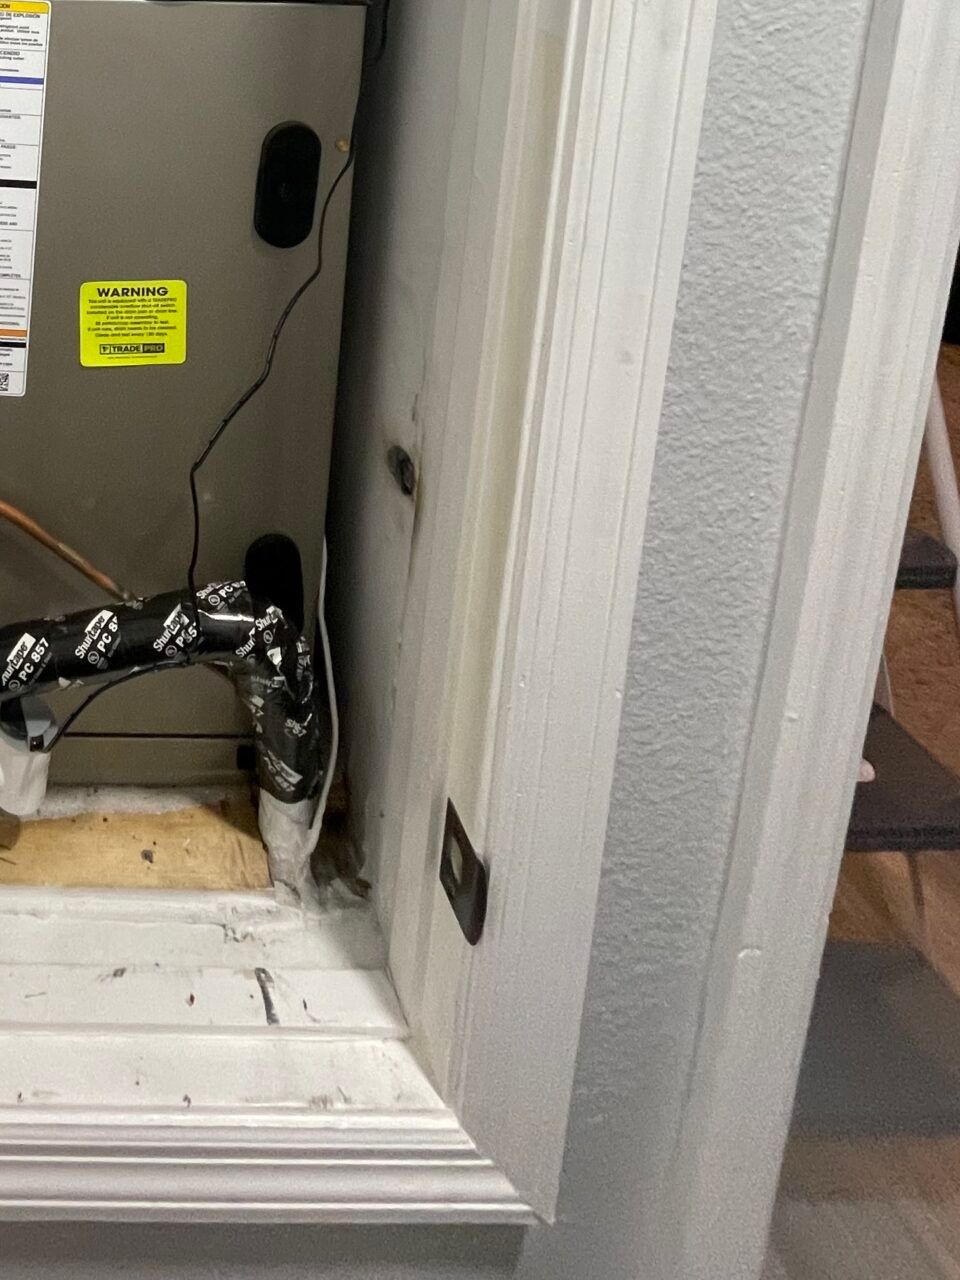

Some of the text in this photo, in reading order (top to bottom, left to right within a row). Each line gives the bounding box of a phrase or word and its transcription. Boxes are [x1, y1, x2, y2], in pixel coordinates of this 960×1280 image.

[96, 286, 169, 298] WARNING
[75, 611, 110, 659] Shurtape
[97, 632, 112, 653] PC
[30, 636, 50, 663] 857
[18, 662, 34, 681] PC
